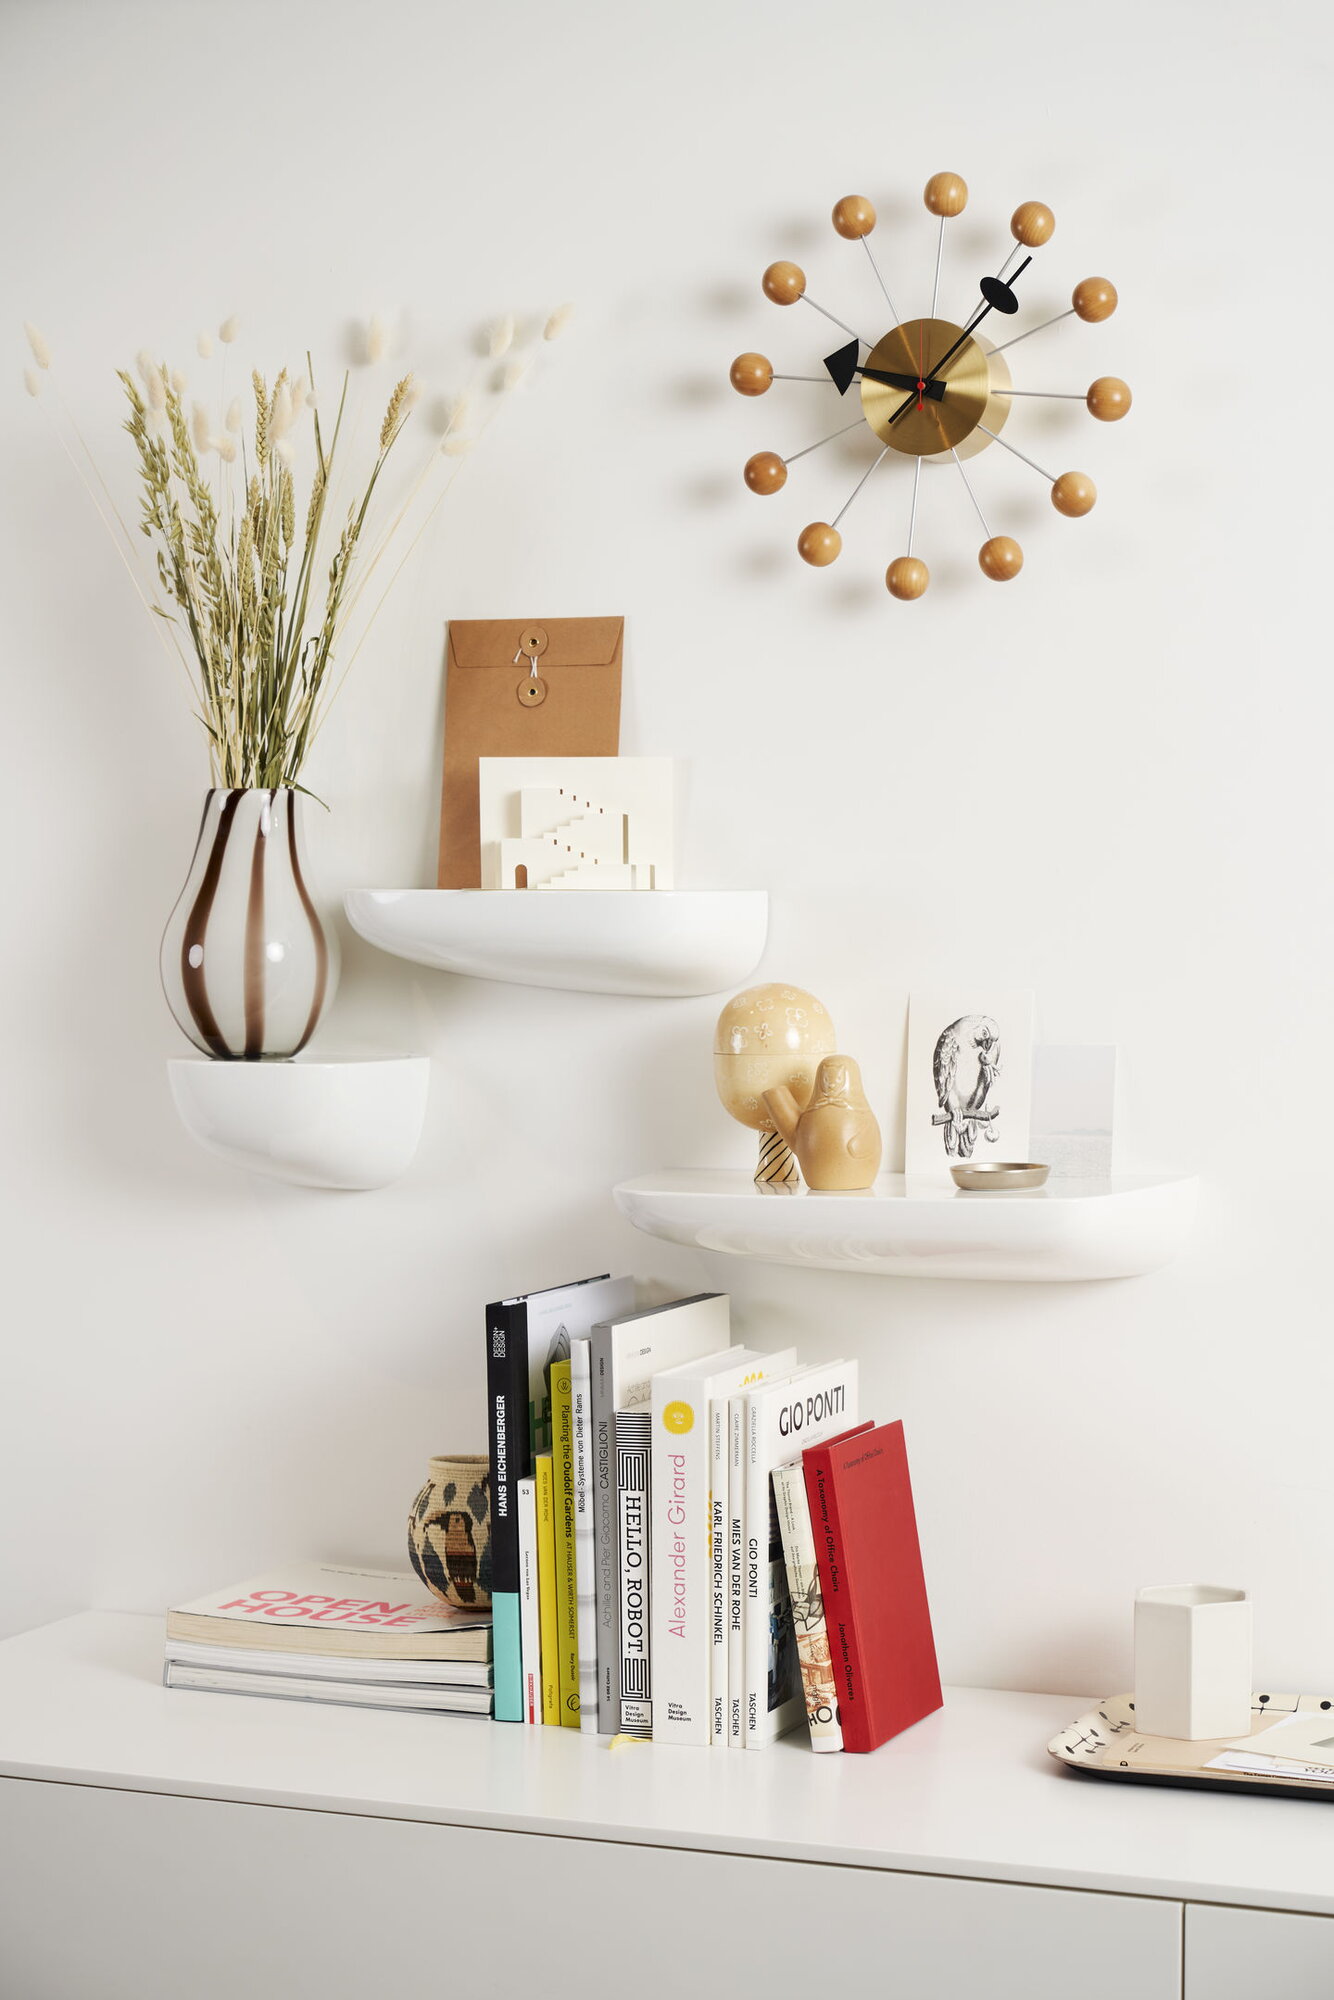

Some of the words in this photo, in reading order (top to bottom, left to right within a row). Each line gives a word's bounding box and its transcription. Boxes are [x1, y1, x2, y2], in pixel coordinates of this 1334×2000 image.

[560, 1405, 570, 1442] Planting
[779, 1402, 804, 1436] GIO
[806, 1384, 845, 1426] PONTI
[496, 1395, 507, 1482] EICHENBERGER
[562, 1444, 572, 1459] the
[599, 1421, 609, 1489] CASTIGLIONI
[563, 1461, 573, 1494] Oudolf
[578, 1456, 587, 1487] Systeme
[498, 1485, 508, 1517] HANS
[578, 1491, 586, 1513] Möbel
[668, 1454, 686, 1525] Girard
[818, 1478, 829, 1522] Taxonomy
[564, 1499, 574, 1538] Gardens
[600, 1494, 610, 1545] Giacomo
[713, 1501, 723, 1529] KARL
[732, 1518, 741, 1545] MIES
[825, 1526, 833, 1534] of
[624, 1496, 642, 1573] HELLO,
[748, 1538, 758, 1560] GIO
[825, 1536, 836, 1563] Office
[601, 1546, 611, 1567] Pier
[714, 1531, 723, 1589] FRIEDRICH
[732, 1549, 741, 1571] VAN
[601, 1569, 611, 1589] and
[668, 1532, 686, 1638] Alexander
[732, 1574, 741, 1596] DER
[748, 1563, 758, 1598] PONTI
[830, 1566, 839, 1592] Chairs
[217, 1599, 427, 1627] HOUSE
[249, 1590, 411, 1614] OPEN
[602, 1593, 612, 1628] Achille
[627, 1578, 643, 1654] ROBOT.
[714, 1592, 723, 1646] SCHINKEL
[732, 1599, 741, 1631] ROHE
[838, 1623, 849, 1662] Jonathan
[844, 1664, 855, 1701] Olivares
[668, 1708, 687, 1716] Design
[714, 1697, 722, 1735] TASCHEN
[732, 1698, 740, 1736] TASCHEN
[748, 1692, 757, 1731] TASCHEN
